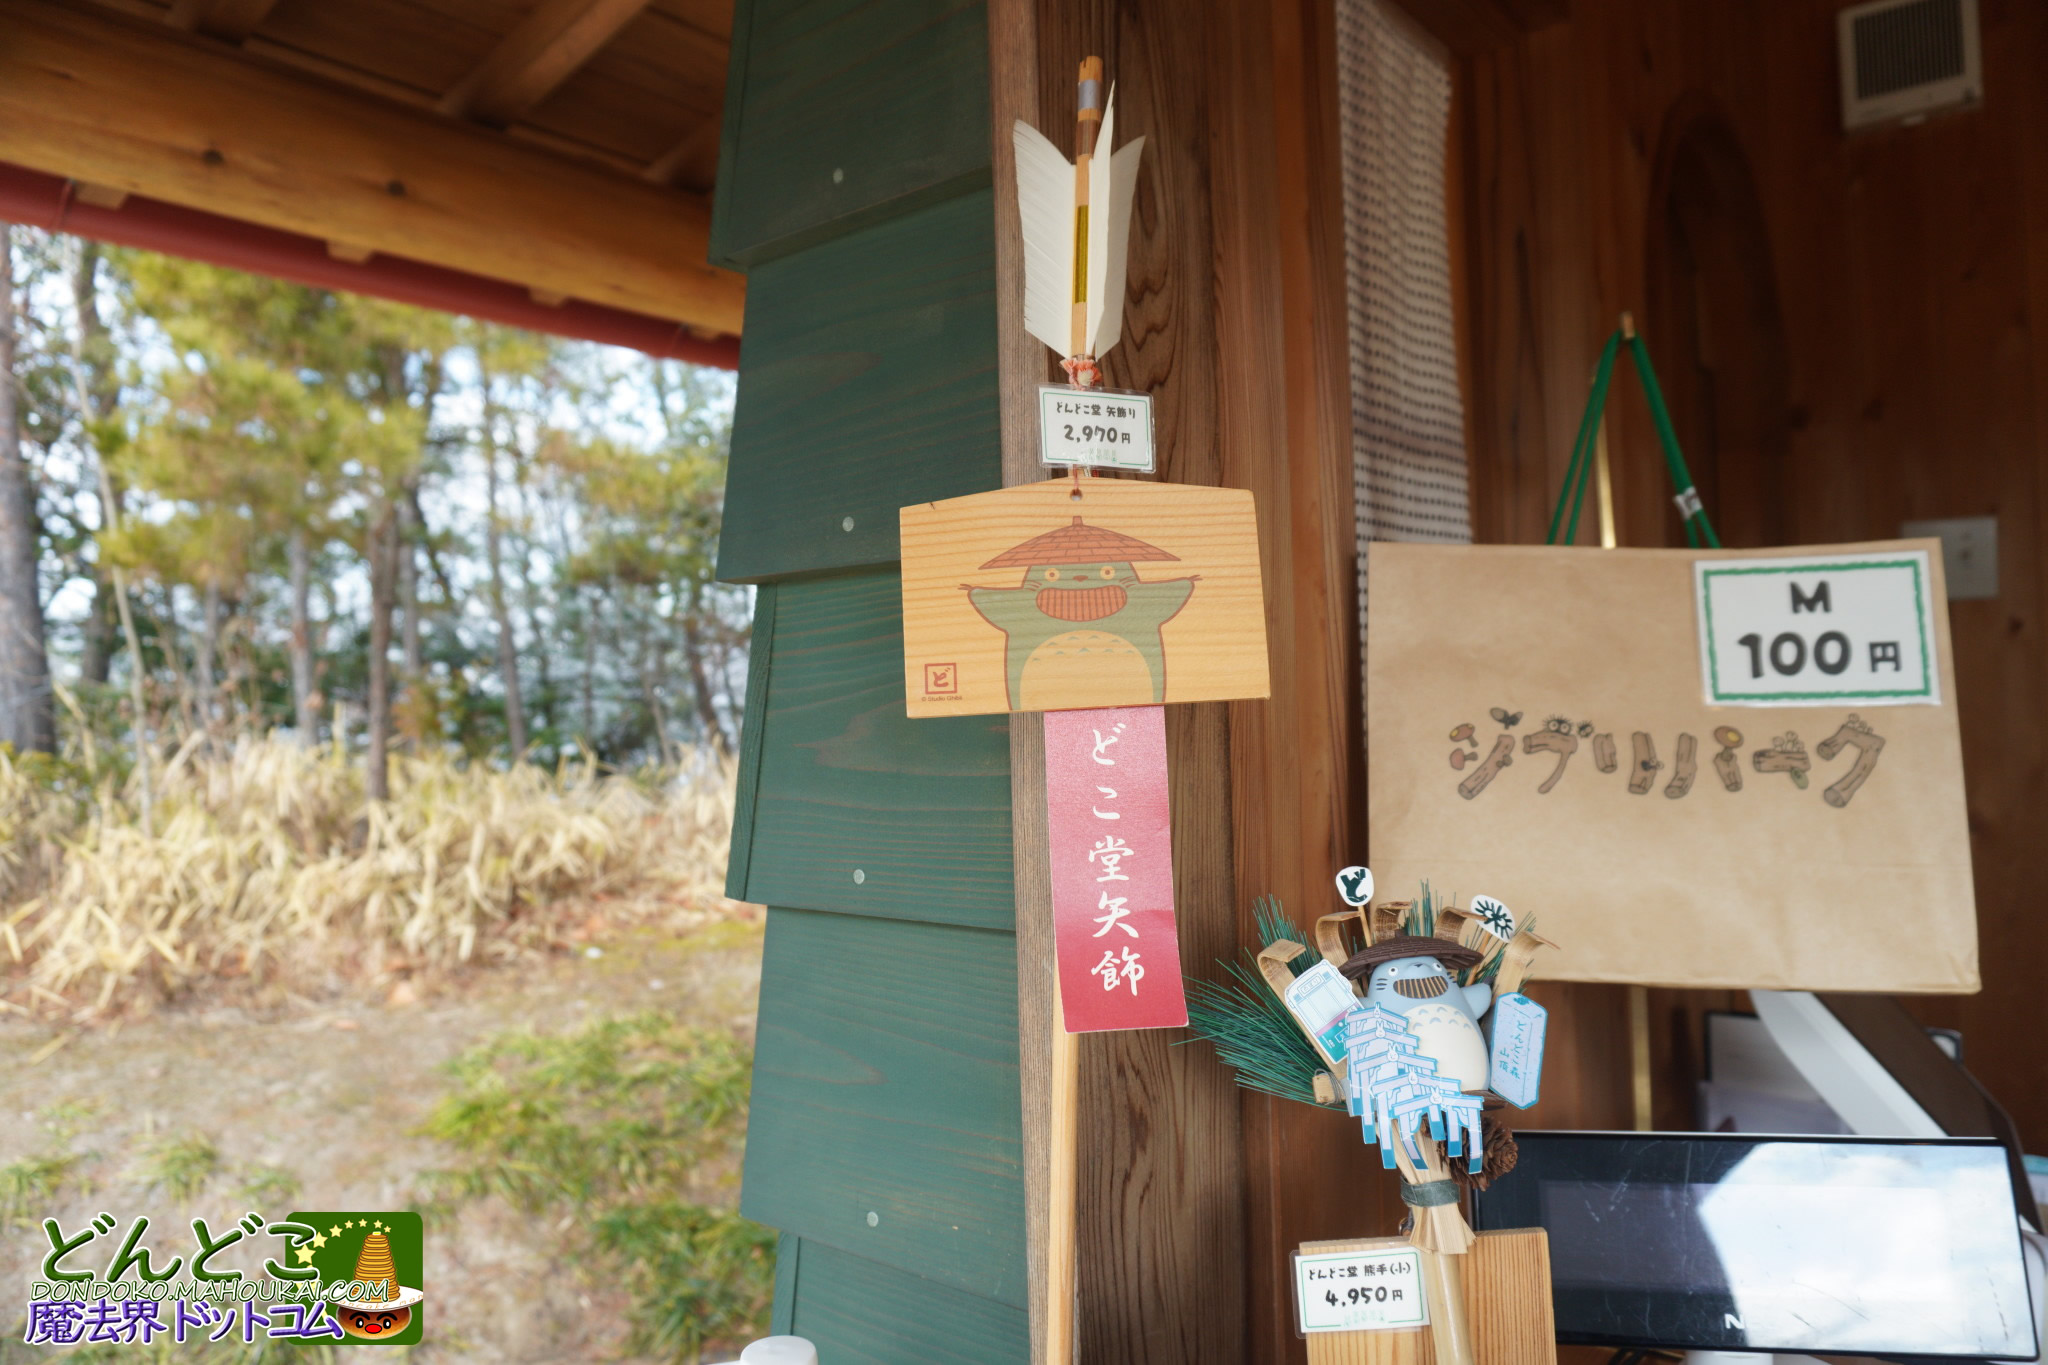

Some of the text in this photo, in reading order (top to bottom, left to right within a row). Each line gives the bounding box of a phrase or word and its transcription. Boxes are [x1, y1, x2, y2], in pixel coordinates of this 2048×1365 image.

[1056, 401, 1136, 419] どんどこ堂 矢飾り
[1789, 579, 1833, 615] M
[1449, 706, 1886, 808] ジブリパーク
[1308, 1265, 1359, 1281] どんどこ堂
